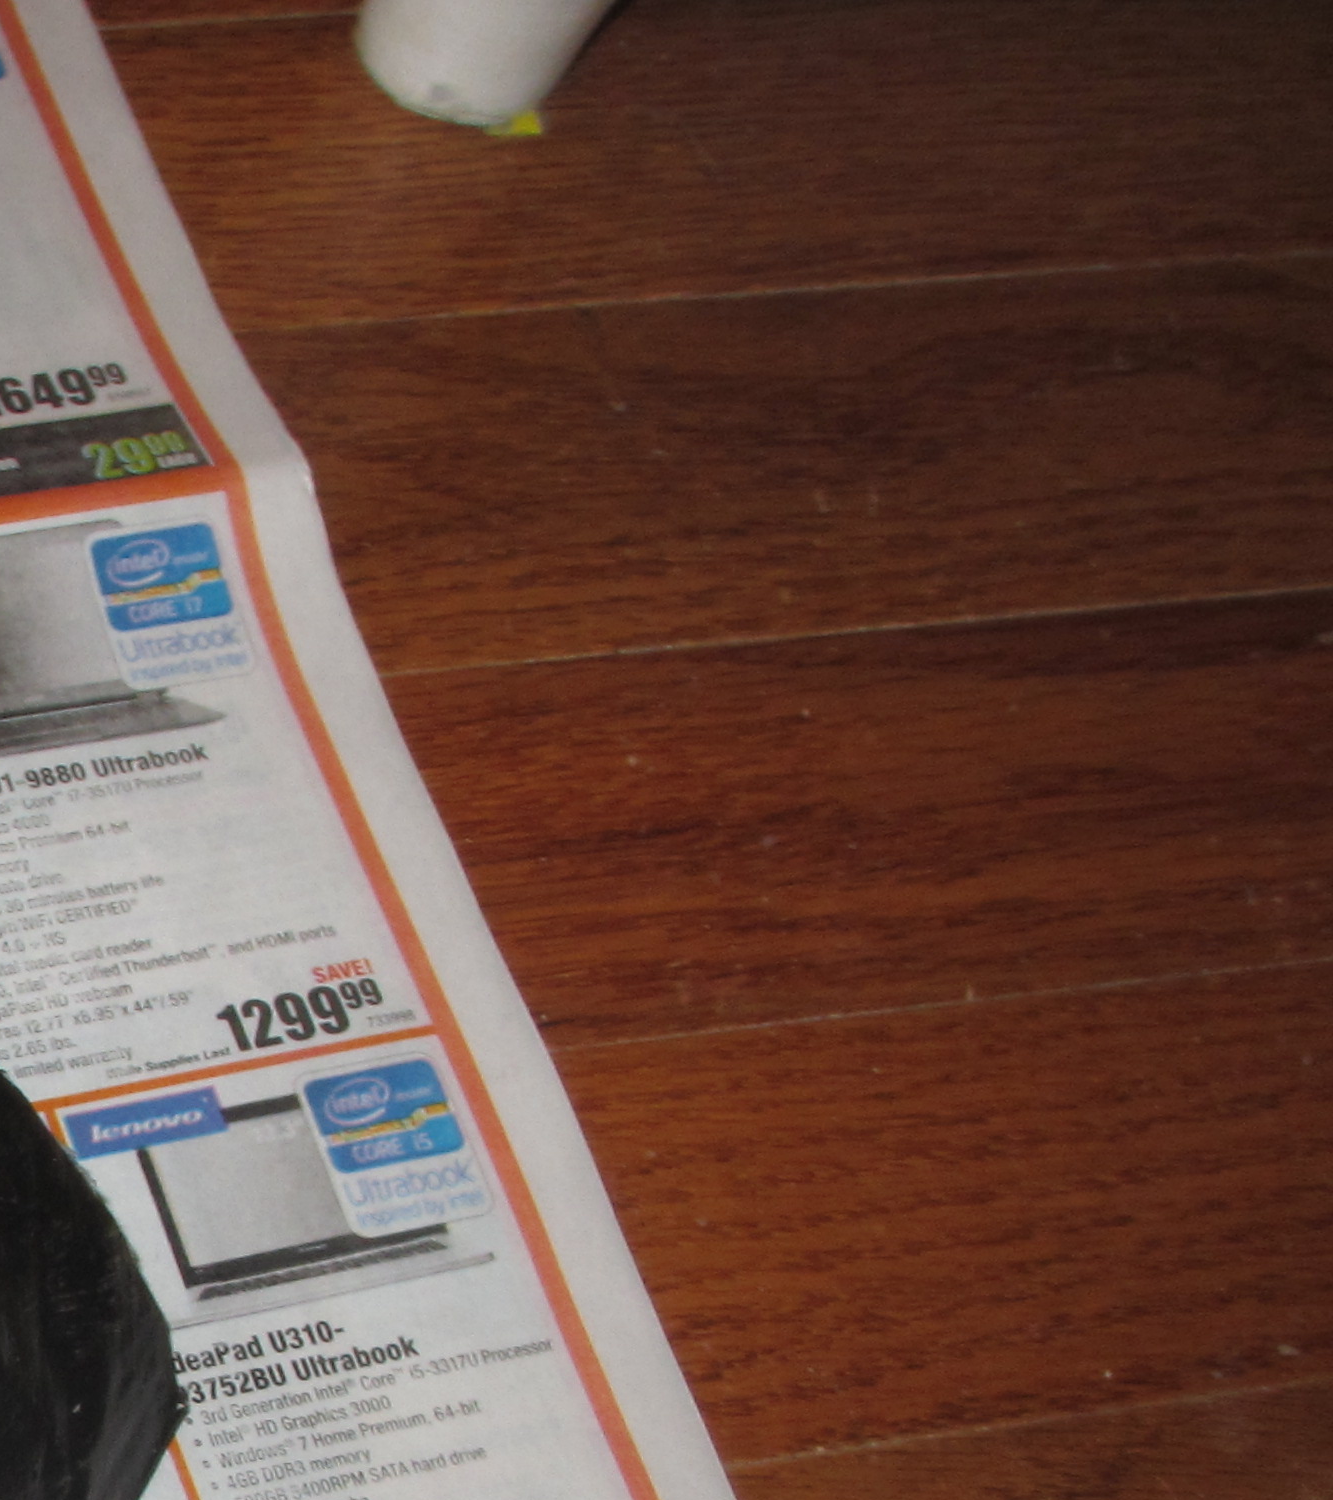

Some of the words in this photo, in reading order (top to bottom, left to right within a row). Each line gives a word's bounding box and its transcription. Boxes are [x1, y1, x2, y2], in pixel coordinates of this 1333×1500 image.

[91, 744, 208, 777] Ultrabook
[312, 958, 373, 985] SAVE!
[90, 1109, 204, 1145] lenovo
[345, 1162, 472, 1207] Ultrabook
[268, 1321, 343, 1353] U310-
[293, 1338, 418, 1381] Ultrabook
